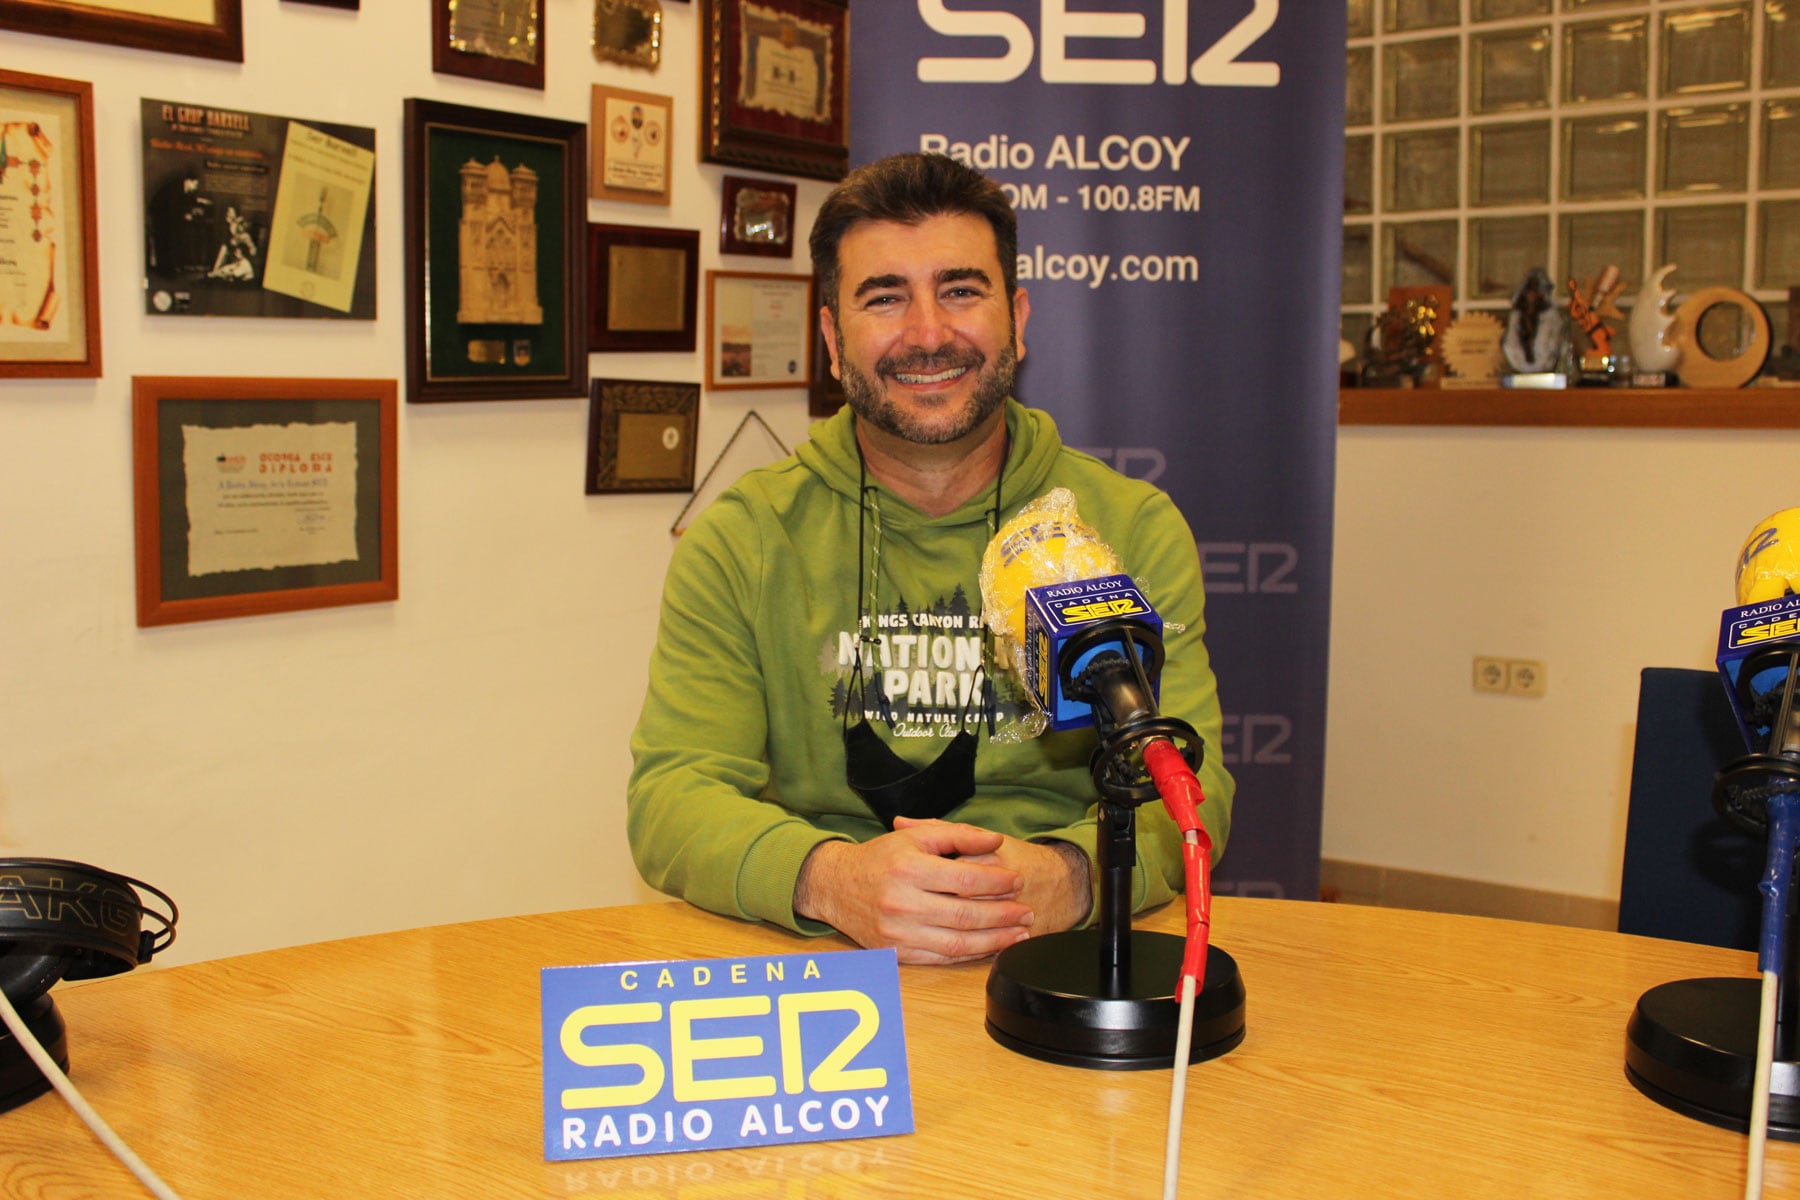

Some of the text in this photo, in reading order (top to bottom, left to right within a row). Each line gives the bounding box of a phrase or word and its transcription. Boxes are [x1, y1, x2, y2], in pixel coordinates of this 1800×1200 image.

[917, 0, 1280, 87] SER
[920, 134, 1191, 171] Radio ALCOY
[1078, 185, 1200, 212] 100.8FM
[1016, 245, 1199, 289] alcoy.com
[1199, 542, 1298, 594] ER
[1046, 580, 1122, 598] RADIO ALCOY
[1054, 592, 1133, 608] CADENA
[1062, 599, 1143, 623] SER
[1739, 613, 1798, 629] CADE
[1741, 603, 1782, 618] RADIO
[1737, 618, 1800, 645] SE
[884, 670, 985, 706] PARK
[907, 712, 957, 724] NATURE
[1222, 714, 1293, 765] ER
[0, 875, 132, 936] AKG
[619, 959, 821, 991] CADENA
[560, 989, 887, 1110] SER
[563, 1095, 889, 1149] RADIO ALCOY
